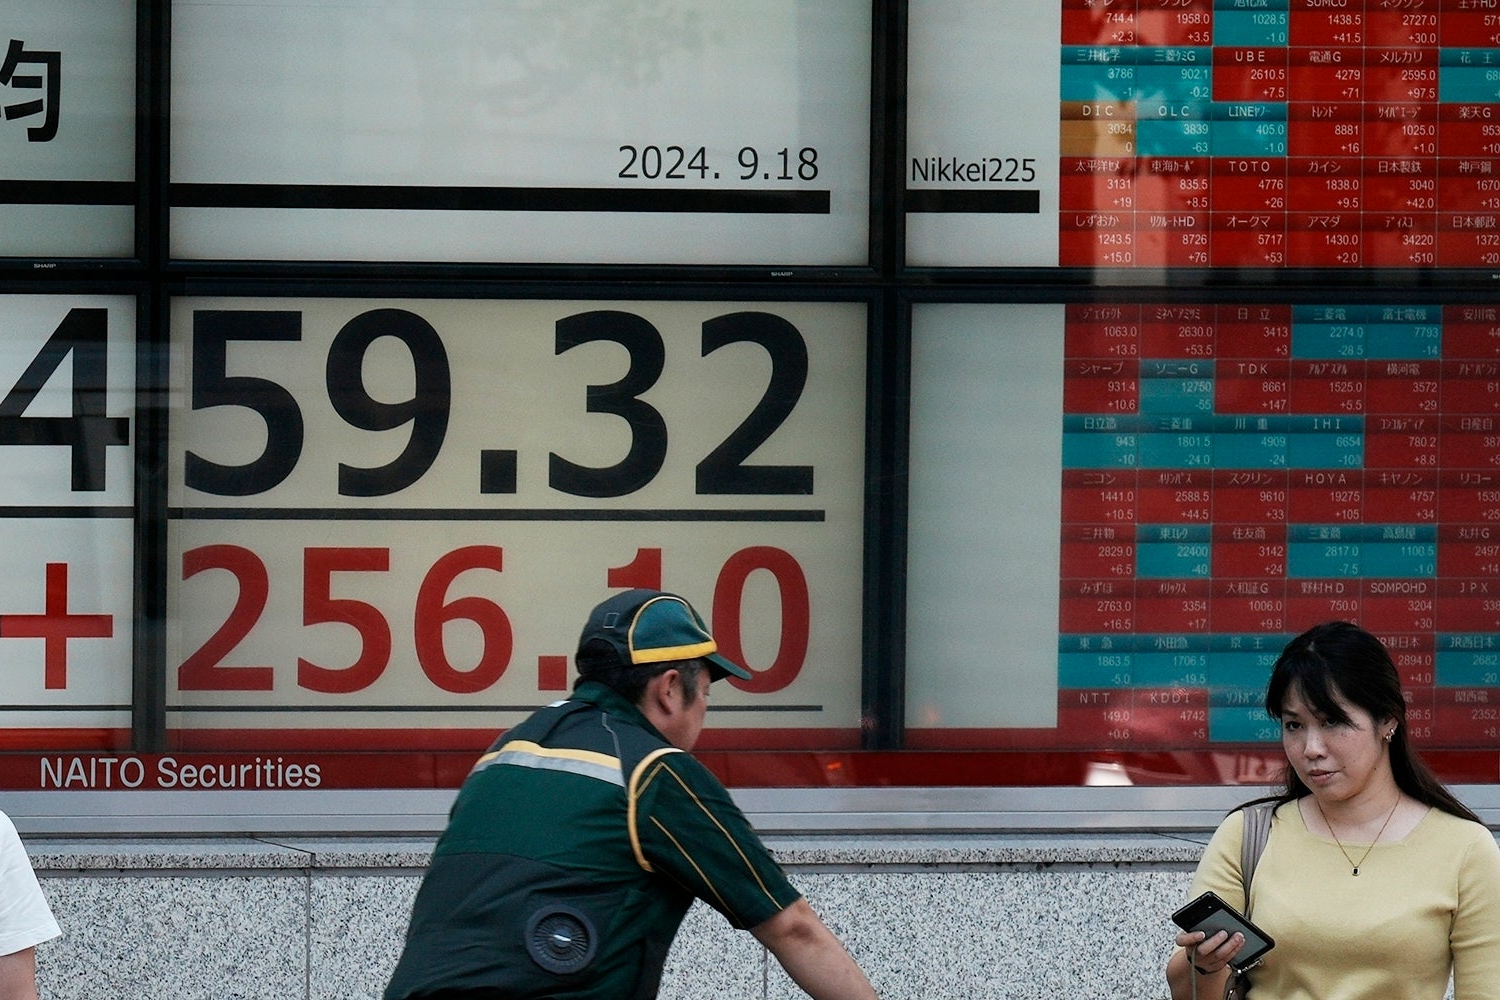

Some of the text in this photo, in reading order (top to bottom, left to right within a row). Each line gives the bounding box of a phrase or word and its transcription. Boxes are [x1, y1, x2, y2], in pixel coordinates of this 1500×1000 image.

[1106, 13, 1133, 24] 744.4
[1177, 14, 1210, 24] 1958.0
[1253, 14, 1285, 24] 1028.5
[1328, 15, 1361, 25] 1438.5
[1403, 15, 1436, 26] 2727.0
[1111, 32, 1134, 41] +2.3
[1187, 32, 1209, 42] +3.5
[1266, 34, 1286, 43] -1.0
[1333, 33, 1360, 43] +41.5
[1408, 34, 1436, 43] +30.0
[1108, 68, 1133, 79] 3786
[1181, 69, 1207, 79] 902.1
[1251, 69, 1284, 80] 2610.5
[1335, 70, 1360, 80] 4279
[1402, 70, 1435, 80] 2595.0
[1122, 88, 1133, 97] -1
[1190, 86, 1208, 97] -0.2
[1263, 88, 1285, 97] +7.5
[1342, 88, 1358, 98] +71
[1408, 88, 1435, 98] +97.5
[1108, 124, 1132, 134] 3034
[1184, 124, 1208, 134] 3839
[1256, 125, 1284, 135] 405.0
[1335, 125, 1358, 135] 8881
[1402, 125, 1434, 135] 1025.0
[1126, 142, 1132, 152] 0
[1192, 143, 1209, 153] -63
[1265, 143, 1284, 153] -1.0
[1341, 143, 1359, 153] +16
[1414, 143, 1434, 153] +1.0
[911, 157, 1037, 183] Nikkei225
[1108, 179, 1130, 189] 3131
[1180, 179, 1207, 190] 835.5
[1259, 179, 1283, 189] 4776
[1326, 180, 1358, 190] 1838.0
[1410, 180, 1434, 190] 3040
[1113, 197, 1131, 207] +19
[1187, 197, 1207, 207] +8.5
[1265, 197, 1283, 208] +26
[1337, 198, 1358, 208] +9.5
[1406, 198, 1434, 208] +42.0
[1099, 234, 1131, 244] 1243.5
[1183, 234, 1207, 244] 8726
[1258, 234, 1282, 244] 5717
[1326, 235, 1358, 245] 1430.0
[1403, 235, 1433, 245] 34220
[1104, 252, 1131, 262] +15.0
[1189, 252, 1207, 262] +76
[1264, 252, 1282, 263] +53
[1337, 252, 1357, 263] +2.0
[1409, 252, 1433, 263] +510
[1104, 326, 1137, 337] 1063.0
[1179, 327, 1212, 337] 2630.0
[1264, 327, 1288, 337] 3413
[1109, 344, 1136, 355] +13.5
[1185, 345, 1212, 355] +53.5
[1275, 344, 1288, 355] +3
[1108, 381, 1135, 391] 931.4
[1262, 381, 1285, 392] 8661
[1330, 382, 1362, 392] 1525.0
[1262, 400, 1286, 410] +147
[1260, 491, 1284, 502] 9610
[1331, 491, 1360, 502] 19275
[1410, 491, 1434, 501] 4757
[1336, 509, 1359, 520] +105
[1417, 509, 1434, 519] +34
[1259, 546, 1283, 556] 3142
[1098, 601, 1131, 611] 2763.0
[1408, 600, 1432, 611] 3204
[1414, 618, 1432, 628] +30
[1180, 710, 1204, 721] 4742
[40, 757, 321, 788] NAITO Securities
